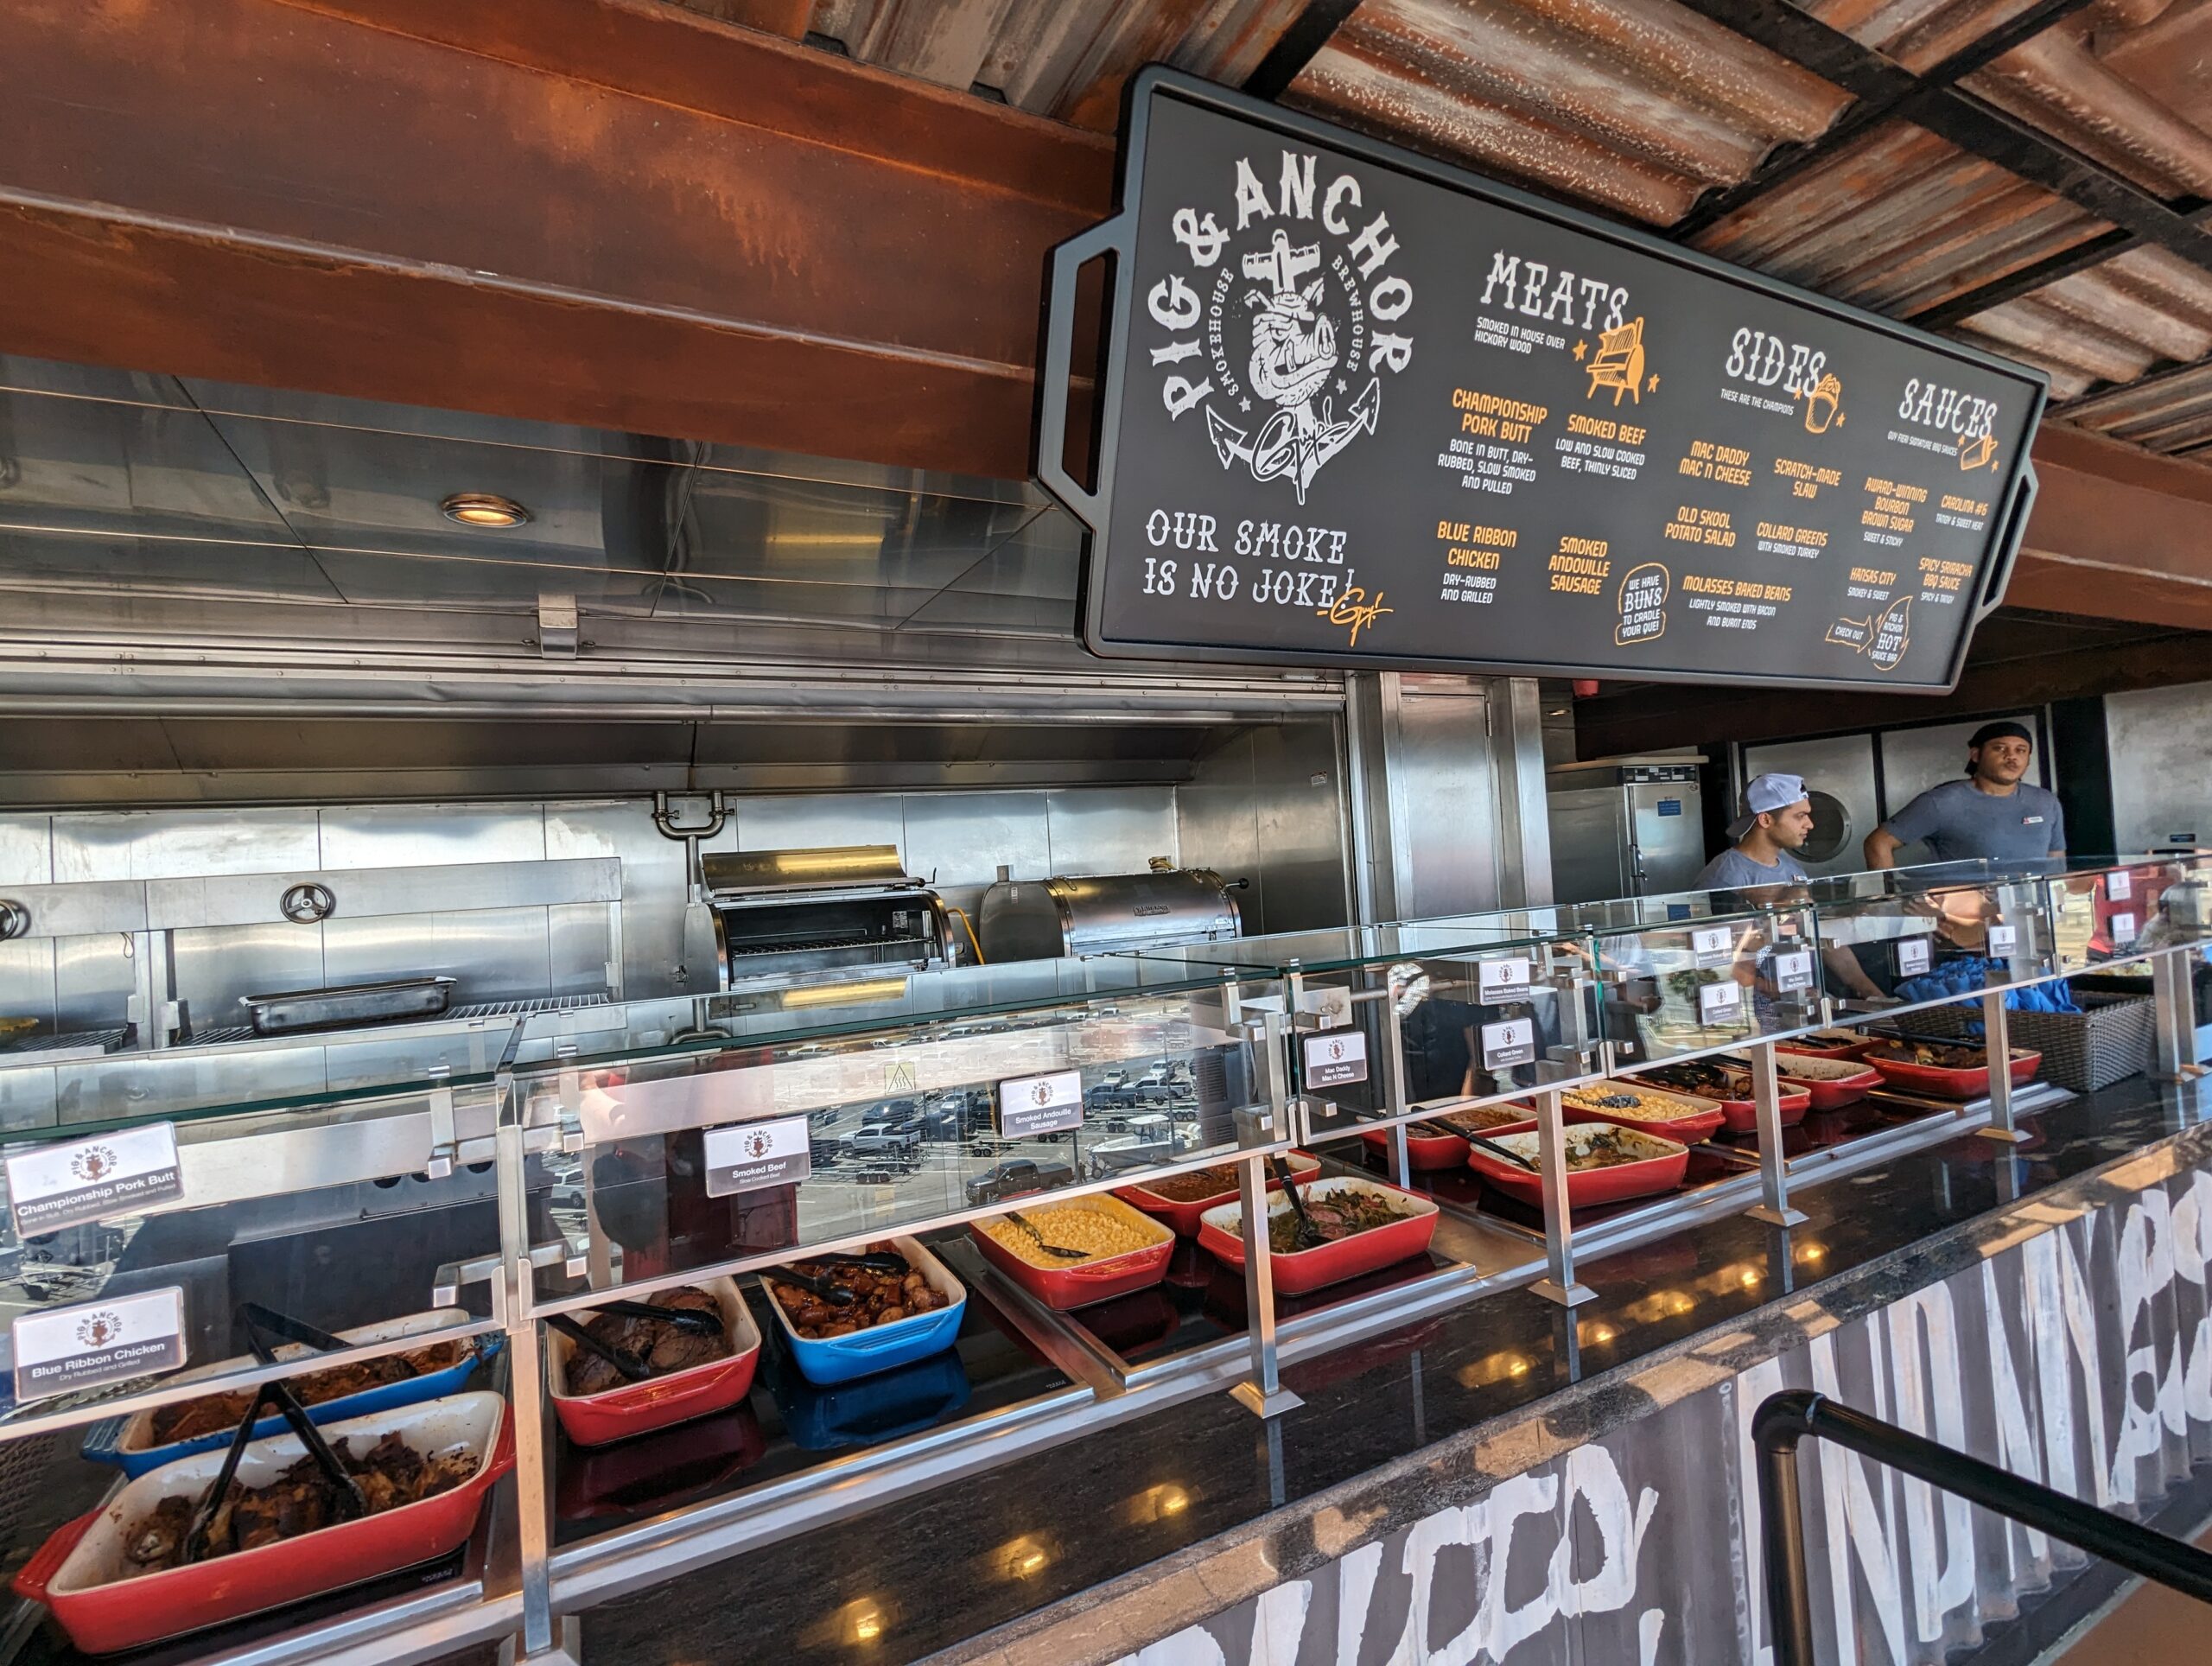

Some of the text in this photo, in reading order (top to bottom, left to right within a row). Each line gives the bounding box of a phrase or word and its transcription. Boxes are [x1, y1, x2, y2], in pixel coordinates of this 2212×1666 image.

[1147, 149, 1414, 422] PIG & ANCHOR
[1480, 249, 1629, 334] MEATS
[1332, 255, 1363, 372] BREWHOUSE
[1209, 268, 1240, 397] SMOKEHOUSE
[1474, 329, 1532, 354] HICKORY WOOD
[1476, 316, 1566, 350] SMOKED IN HOUSE OVER
[1726, 327, 1827, 398] SIDES
[1452, 388, 1548, 425] CHAMPIONSHIP
[1720, 388, 1795, 416] THESE ARE THE CHAMPIONS
[1898, 378, 1998, 440] SAUCES
[1461, 413, 1533, 443] PORK BUTT
[1567, 413, 1647, 446] SMOKED BEEF
[1450, 438, 1534, 466] BONE IN BUTT, DRY-
[1555, 437, 1645, 467] LOW AND SLOW COOKED
[1690, 440, 1750, 467] MAC DADDY
[1438, 454, 1536, 482] RUBBED, SLOW SMOKED
[1560, 455, 1637, 480] BEEF, THINLY SLICED
[1679, 457, 1752, 486] MAC N CHEESE
[1774, 458, 1842, 487] SCRATCH-MADE
[1461, 476, 1512, 495] AND PULLED
[1792, 480, 1818, 499] SLAW
[1865, 476, 1929, 503] AWARD-WINNING
[1677, 506, 1731, 529] OLD SKOOL
[1874, 496, 1910, 516] BOURBON
[1941, 494, 1988, 516] CAROLINA #6
[1437, 520, 1517, 548] BLUE RIBBON
[1757, 521, 1828, 547] COLLARD GREENS
[1861, 511, 1915, 533] BROWN SUGAR
[1146, 508, 1348, 565] OUR SMOKE
[1559, 536, 1608, 558] SMOKED
[1664, 522, 1736, 548] POTATO SALAD
[1863, 531, 1880, 544] SWEET
[1447, 547, 1500, 570] CHICKEN
[1758, 541, 1820, 559] WITH SMOKED TURKEY
[1548, 555, 1611, 577] ANDOUILLE
[1849, 567, 1897, 586] KANSAS CITY
[1918, 557, 1974, 577] SPICY SRIRACHA
[1142, 557, 1177, 596] IS
[1190, 563, 1240, 602] NO
[1443, 573, 1497, 590] DRY-RUBBED
[1549, 574, 1602, 595] SAUSAGE
[1629, 575, 1660, 591] WE HAVE
[1681, 575, 1792, 602] MOLASSES BAKED BEANS
[1923, 574, 1961, 590] BBQ SAUCE
[1440, 588, 1493, 605] AND GRILLED
[1624, 588, 1662, 614] BUNS
[1688, 598, 1776, 617] LIGHTLY SMOKED WITH BACON
[1622, 620, 1660, 638] YOUR QUE!
[1623, 608, 1661, 626] TO CRADLE
[1707, 615, 1757, 630] AND BURNT ENDS
[1835, 626, 1864, 640] CHECK OUT
[1876, 633, 1902, 651] HOT
[1015, 1109, 1071, 1124] Smoked Andouille
[1030, 1119, 1058, 1129] Sausage
[71, 1160, 80, 1176] PIG
[85, 1145, 118, 1167] ANCHOR
[732, 1165, 766, 1179] Smoked
[767, 1161, 787, 1173] Beef
[17, 1171, 175, 1217] Championship Pork Butt
[76, 1326, 86, 1340] PIG
[92, 1311, 123, 1333] ANCHOR
[32, 1342, 165, 1378] Blue Ribbon Chicken
[59, 1358, 141, 1382] Dry Rubbed and Grilled
